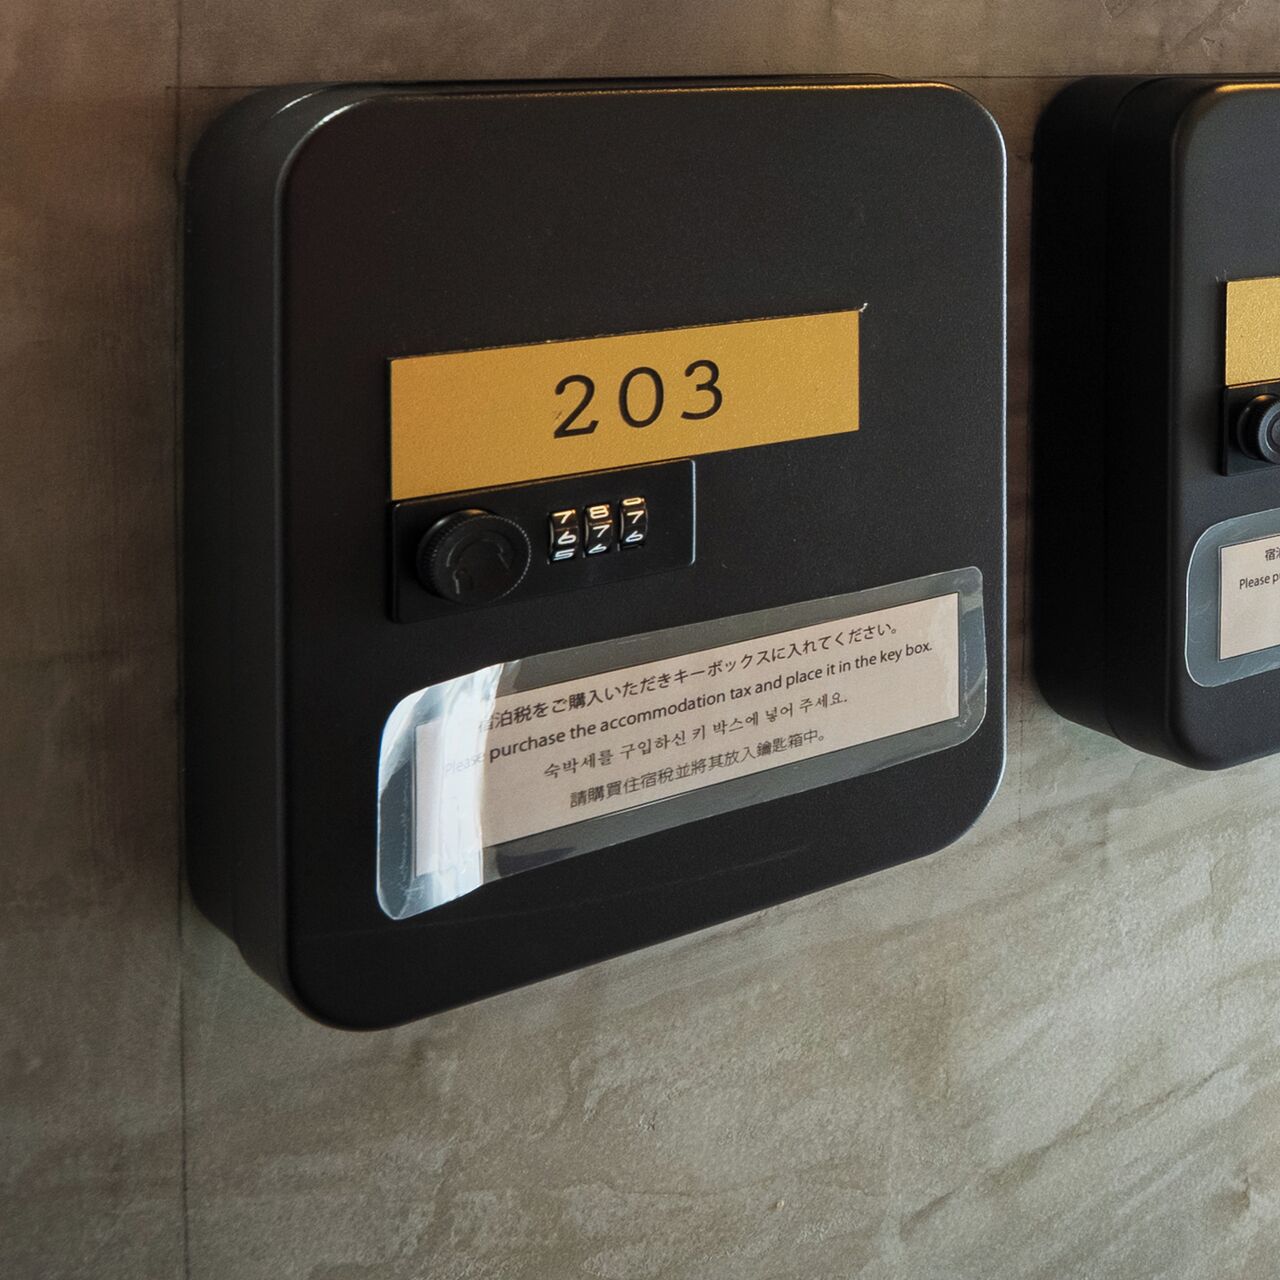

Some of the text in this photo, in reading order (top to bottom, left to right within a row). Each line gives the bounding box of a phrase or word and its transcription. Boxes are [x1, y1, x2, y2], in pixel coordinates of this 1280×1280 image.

[554, 360, 722, 439] 203
[1239, 575, 1271, 590] Please
[488, 731, 566, 764] purchase
[569, 723, 597, 740] the
[599, 692, 726, 733] accommodation
[729, 685, 752, 701] tax
[754, 674, 783, 694] and
[785, 668, 823, 690] place
[826, 663, 836, 677] it
[838, 660, 852, 674] in
[854, 654, 877, 670] the
[879, 648, 903, 664] key
[905, 642, 933, 657] box.
[543, 691, 848, 779] 숙박세를 구입하신 키 박스에 넣어 주세요.
